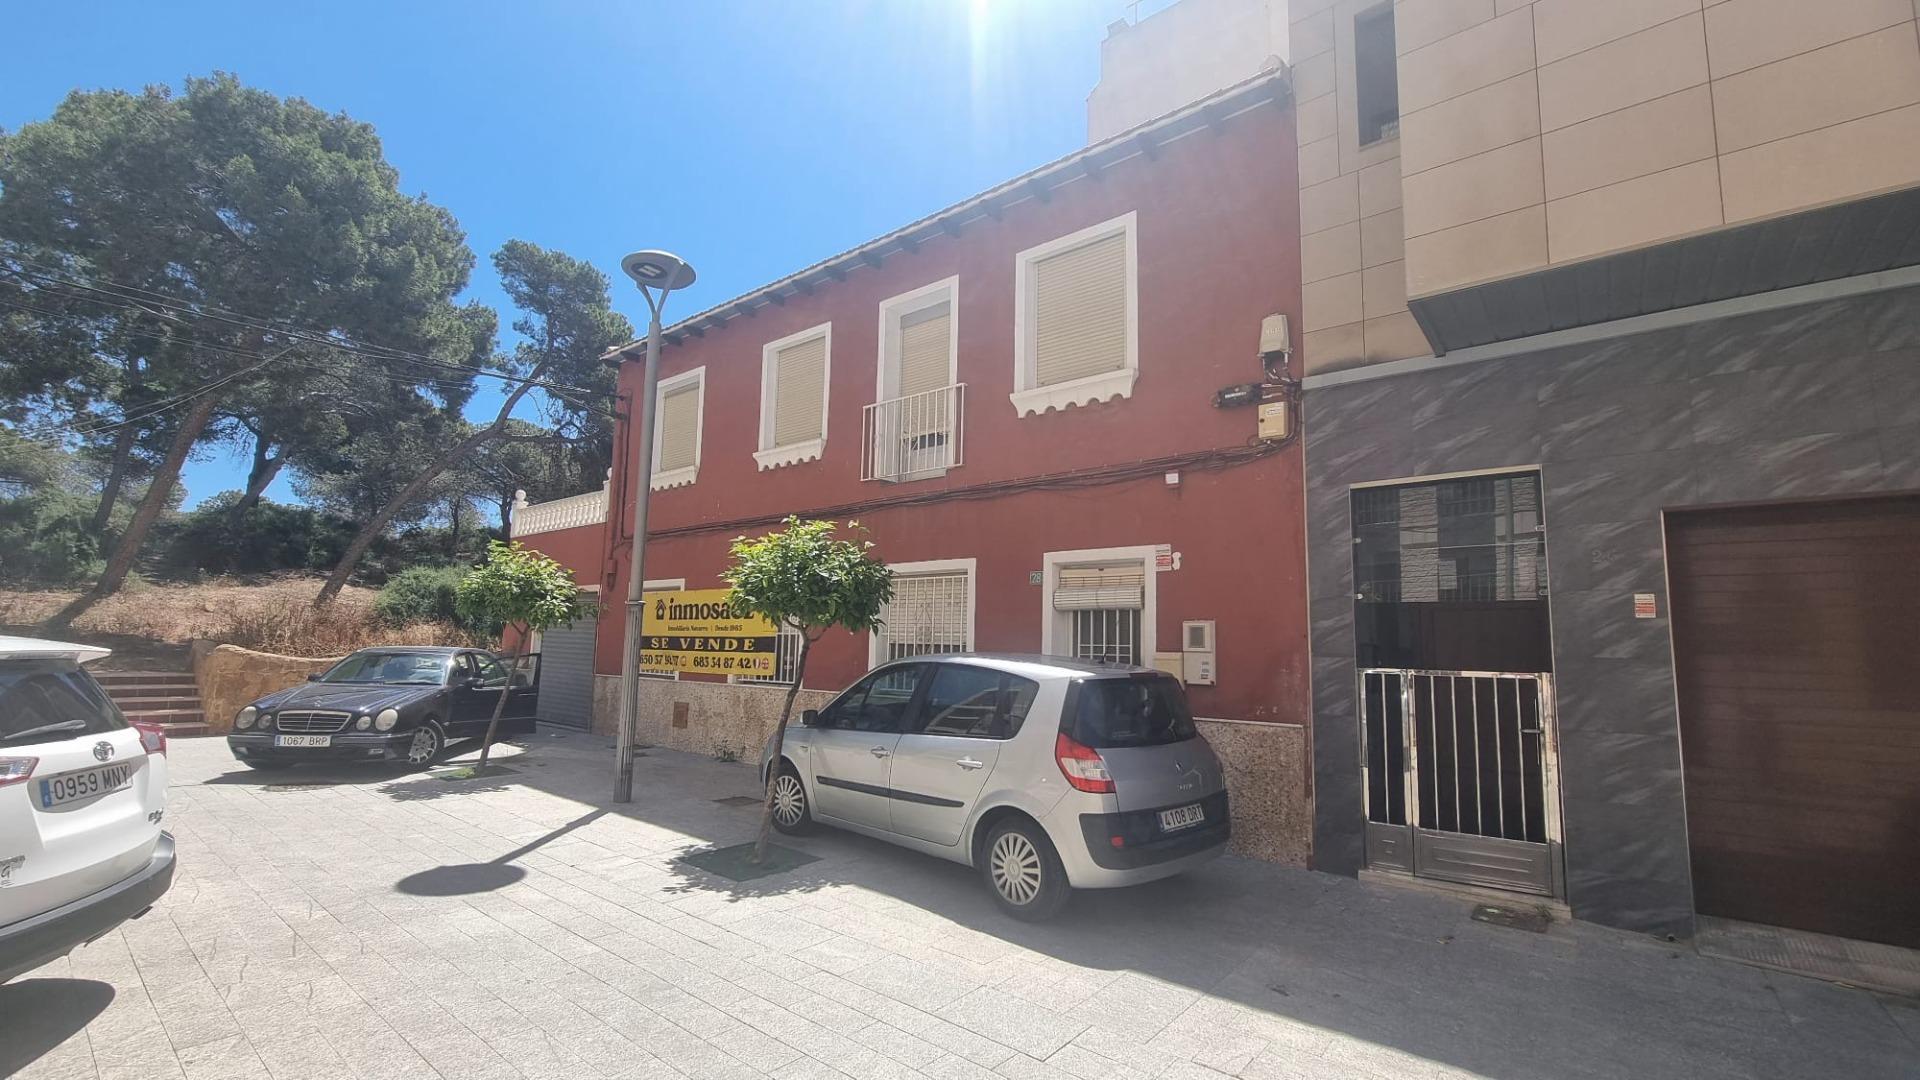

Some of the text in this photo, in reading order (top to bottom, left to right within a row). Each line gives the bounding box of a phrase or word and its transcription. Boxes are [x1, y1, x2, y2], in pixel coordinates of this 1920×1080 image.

[651, 637, 755, 651] SE VENDE
[693, 656, 709, 668] 683
[723, 657, 735, 669] 87
[737, 657, 752, 669] 42
[283, 736, 328, 746] 1067 BRP
[54, 765, 129, 800] 0959 MNY
[1164, 805, 1202, 827] 4108 DRT
